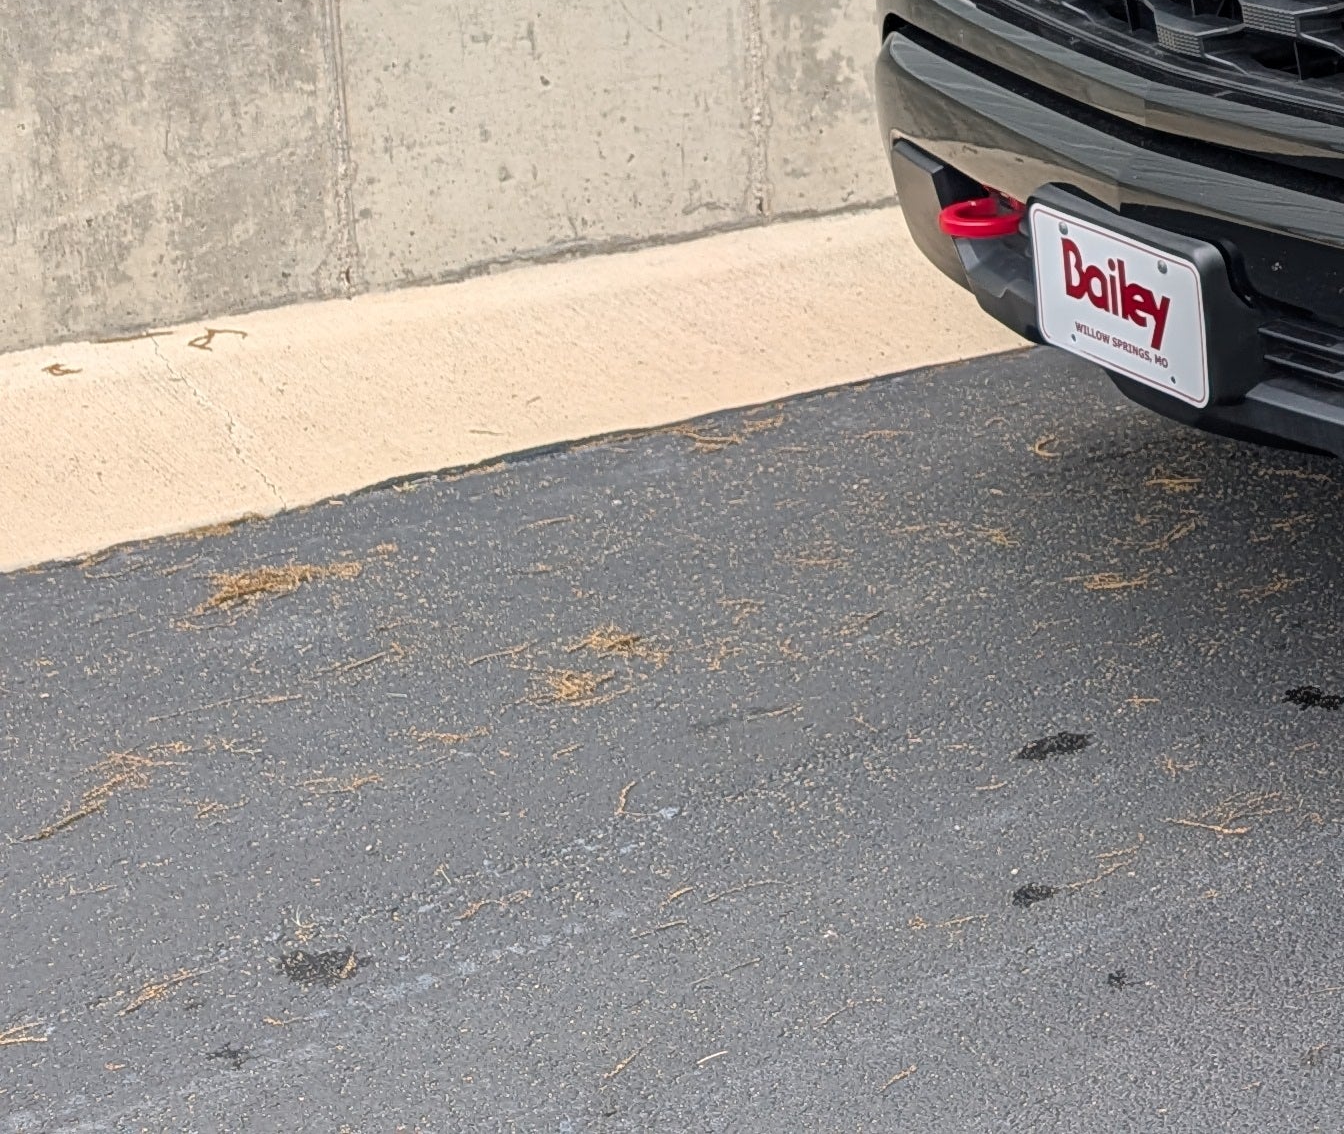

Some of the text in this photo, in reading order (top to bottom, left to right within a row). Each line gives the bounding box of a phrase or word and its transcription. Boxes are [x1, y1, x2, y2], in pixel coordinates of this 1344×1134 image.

[1060, 237, 1171, 351] Bailey
[1075, 320, 1169, 369] WILLOW SPRINGS, MO
